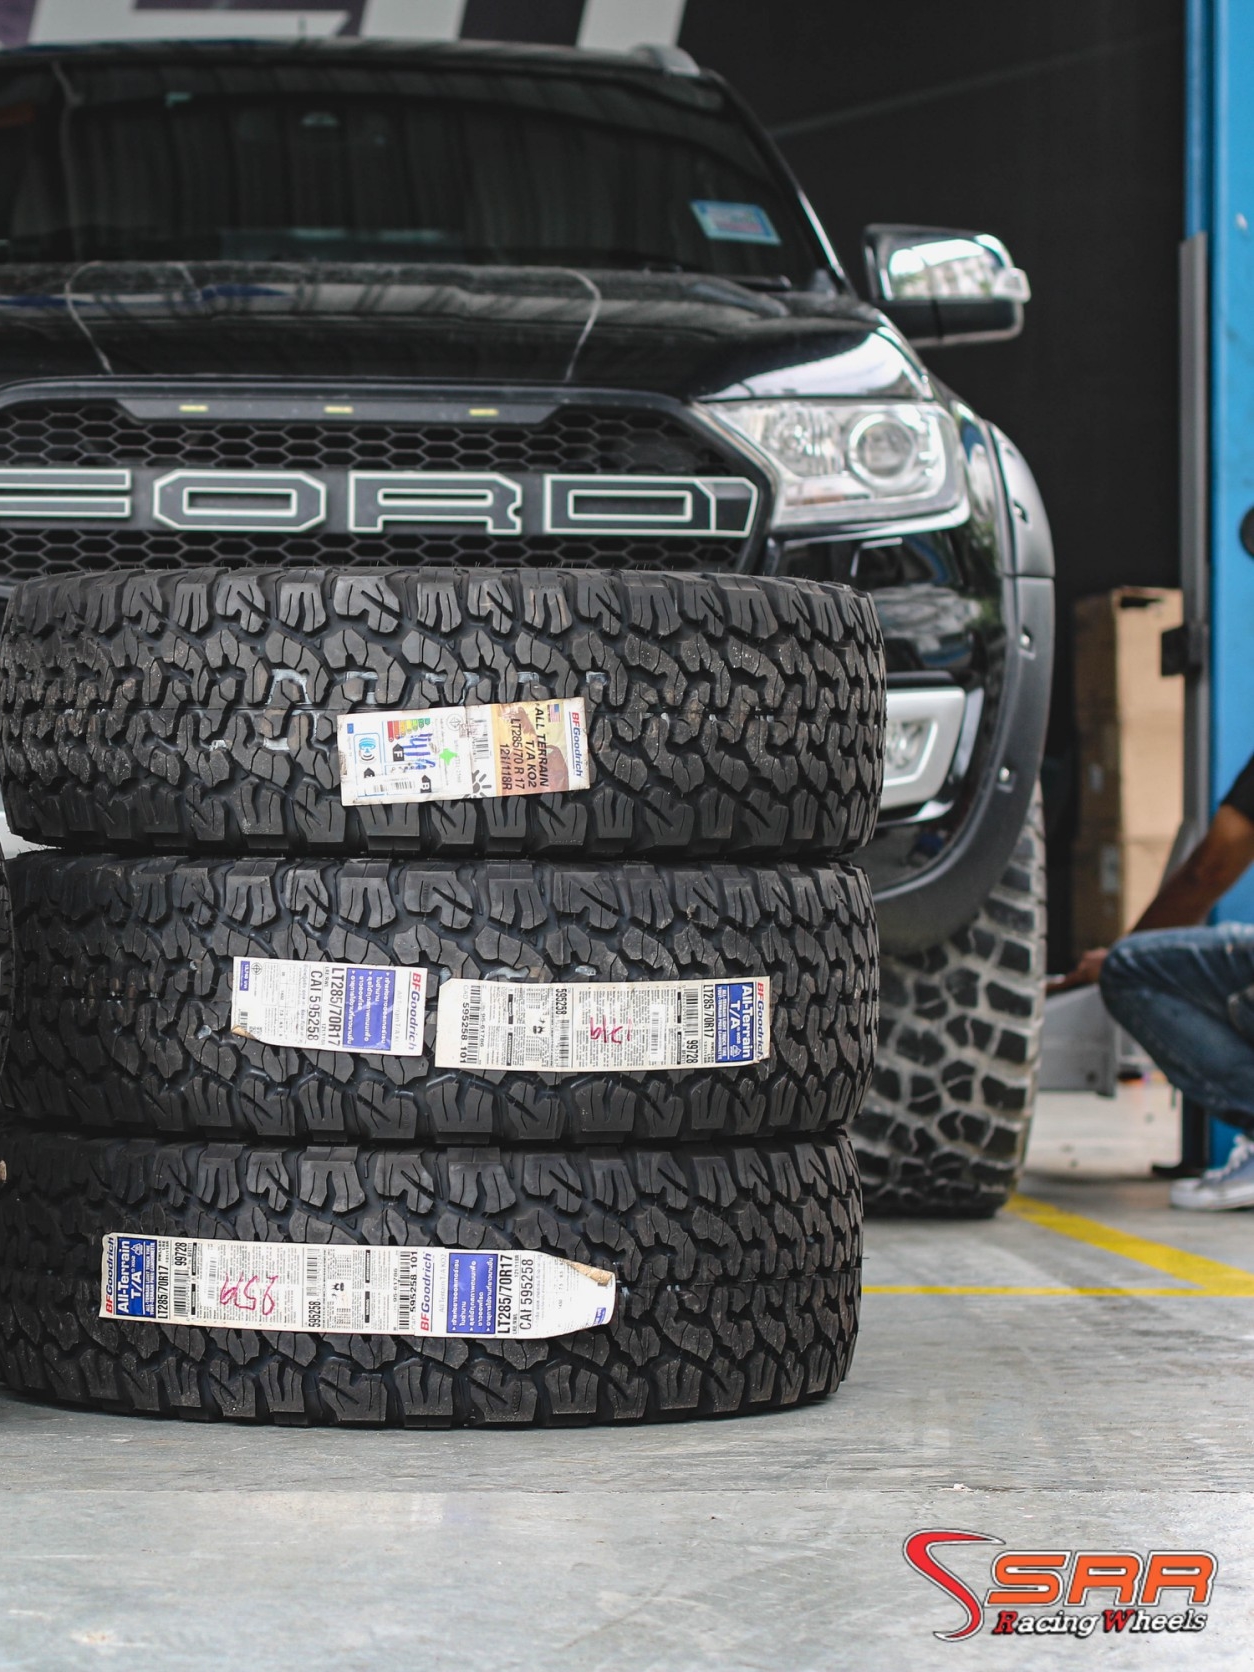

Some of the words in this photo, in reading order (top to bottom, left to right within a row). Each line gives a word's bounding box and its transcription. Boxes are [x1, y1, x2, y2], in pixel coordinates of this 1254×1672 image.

[535, 708, 544, 730] ALL
[510, 718, 523, 764] LT285/70
[525, 740, 535, 760] T/A
[537, 734, 549, 787] TERRAIN
[572, 712, 583, 777] BFGoodrich
[515, 778, 525, 789] 17
[527, 764, 537, 788] KO2
[310, 970, 323, 992] CAI
[555, 988, 567, 1015] 595258
[307, 996, 322, 1041] 595258
[328, 967, 344, 1047] LT285/70R17
[408, 972, 422, 1051] BFGoodrich
[461, 1002, 469, 1041] 595258
[703, 985, 714, 1038] LT285/70R17
[730, 1001, 740, 1029] T/A
[742, 986, 753, 1058] All-Terrain
[460, 1046, 469, 1064] 101
[686, 1040, 699, 1064] 99728
[175, 1242, 187, 1266] 99728
[105, 1237, 114, 1314] BFGoodrich
[117, 1241, 129, 1313] All-Terrain
[131, 1271, 142, 1299] T/A
[158, 1265, 168, 1319] LT285/70R17
[421, 1253, 432, 1331] BFGoodrich
[498, 1255, 512, 1334] LT285/70R17
[521, 1259, 533, 1305] 595258
[308, 1300, 321, 1328] 595258
[519, 1310, 532, 1330] CAI
